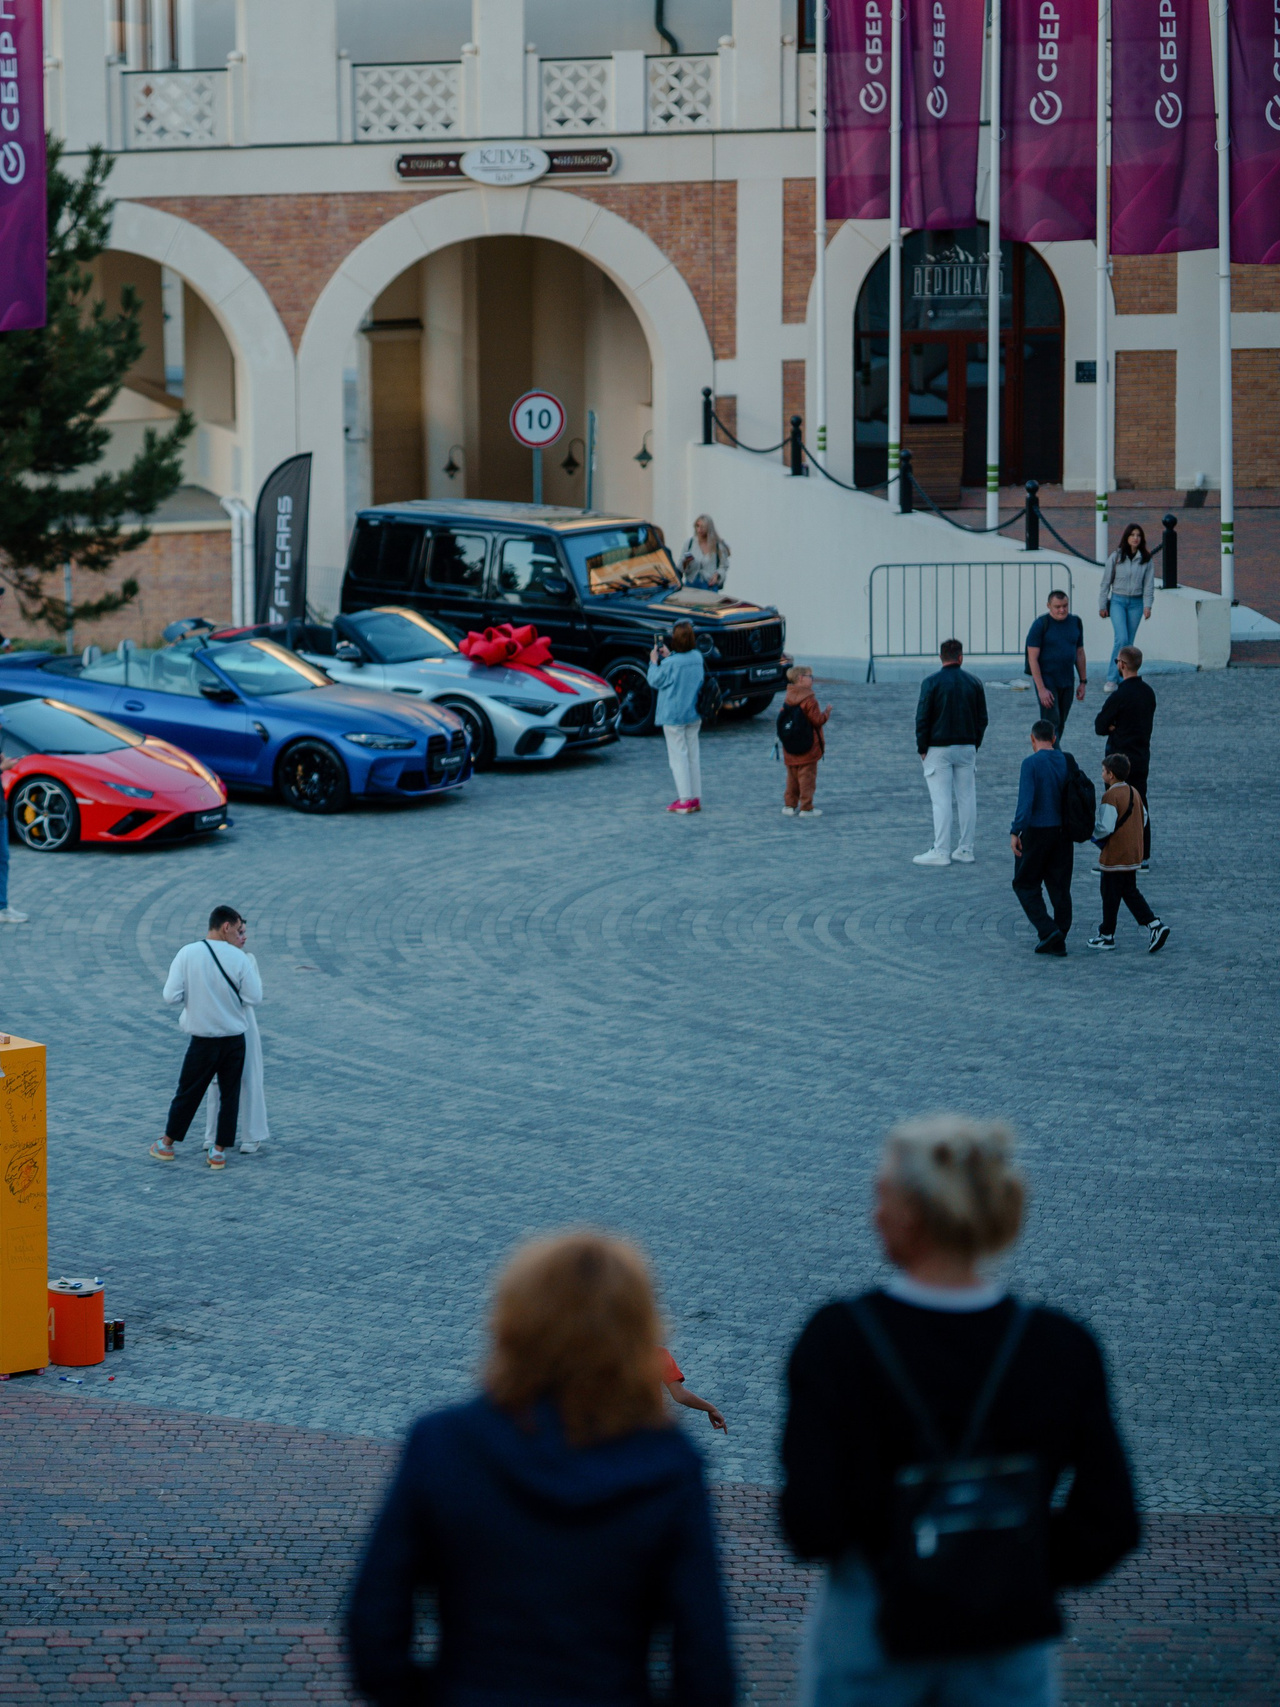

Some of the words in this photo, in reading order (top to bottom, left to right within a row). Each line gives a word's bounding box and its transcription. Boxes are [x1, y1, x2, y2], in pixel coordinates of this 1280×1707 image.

[864, 0, 883, 75] СБЕР
[932, 0, 946, 78] СБЕР
[1036, 0, 1061, 83] СБЕР
[1159, 0, 1177, 84] СБЕР
[0, 31, 20, 132] СБЕР
[478, 148, 530, 164] КЛУБ
[523, 408, 552, 431] 10
[273, 494, 294, 608] FTCARS
